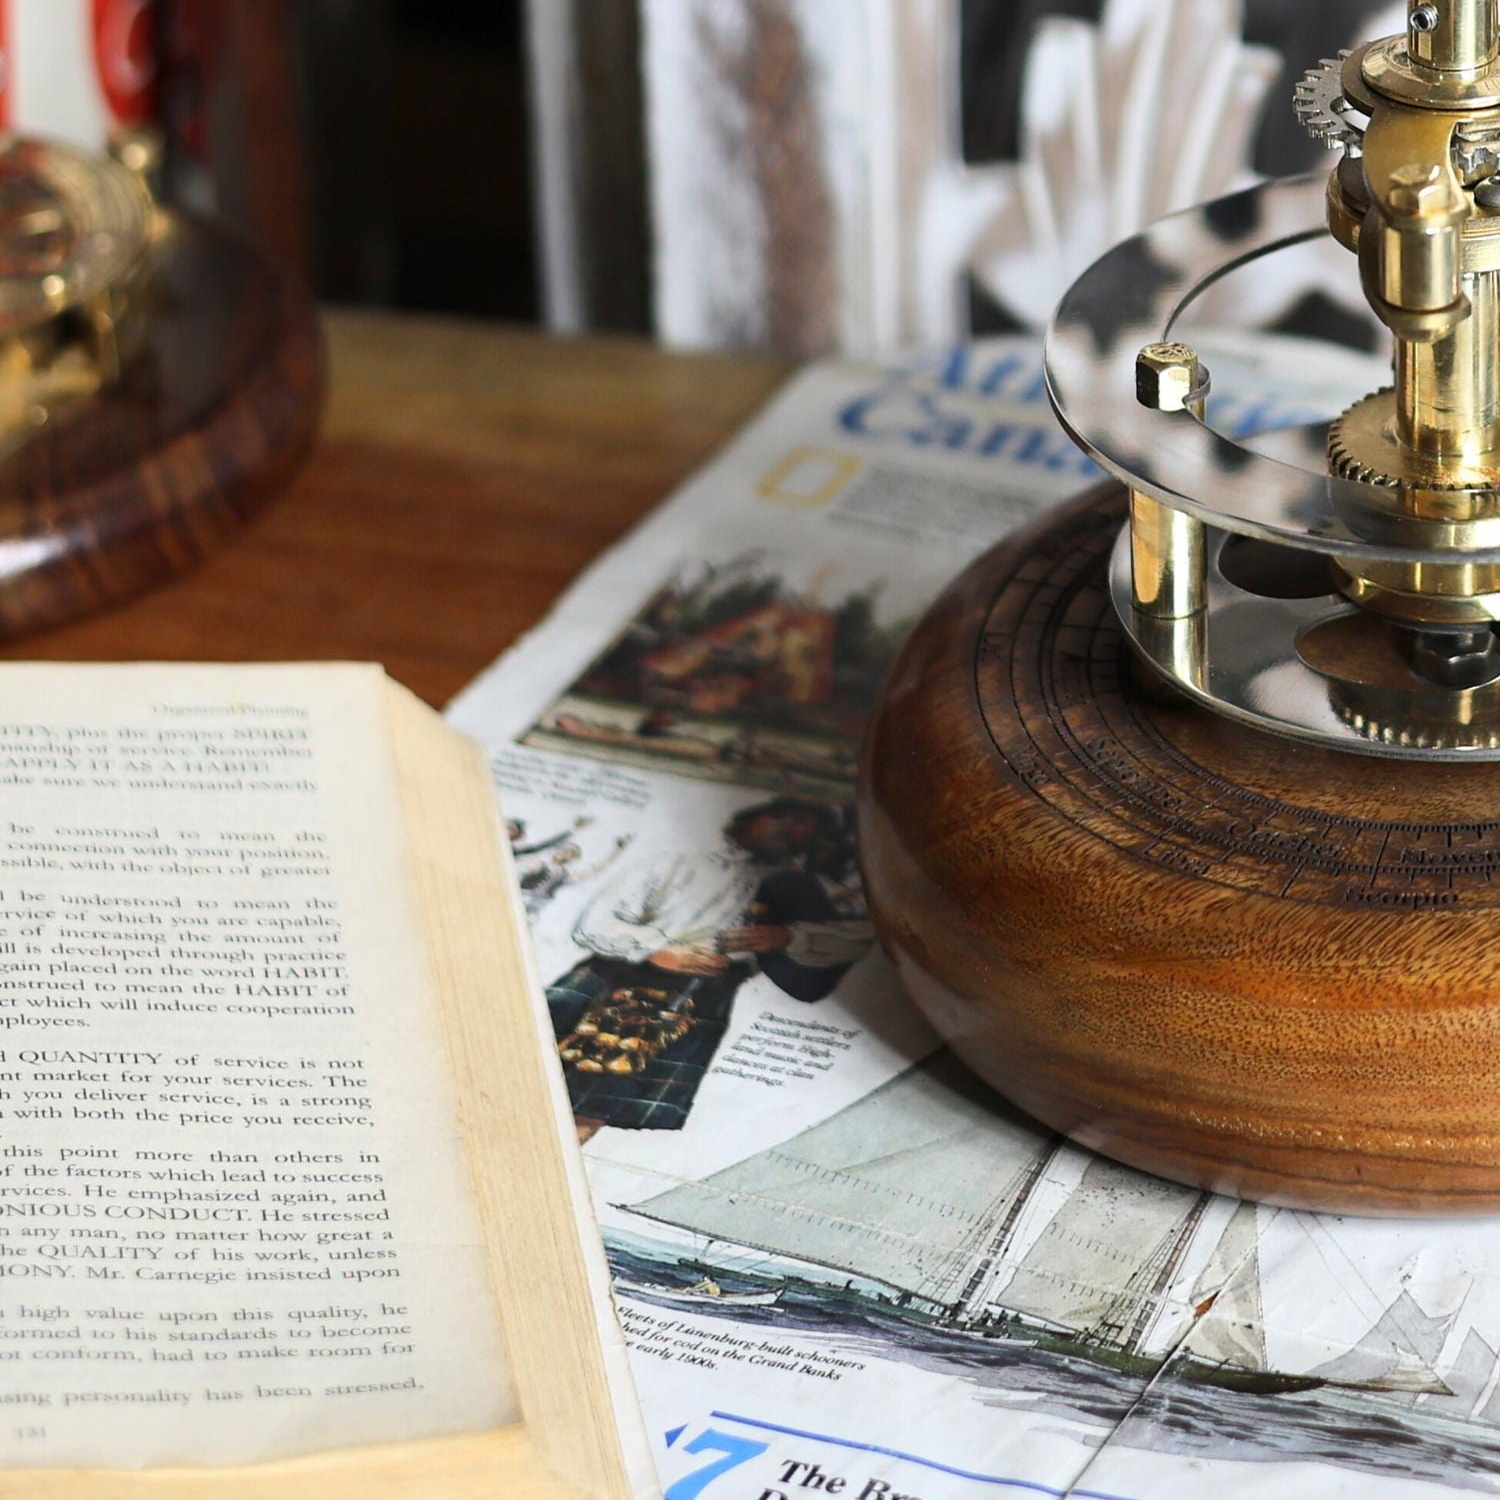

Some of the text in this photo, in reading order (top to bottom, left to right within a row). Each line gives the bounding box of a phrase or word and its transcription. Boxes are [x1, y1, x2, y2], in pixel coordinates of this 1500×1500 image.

[49, 961, 116, 975] placed
[161, 964, 192, 975] the
[200, 967, 254, 977] word
[264, 967, 346, 978] HABIT.
[26, 996, 354, 1017] which will induce cooperation
[18, 1051, 362, 1068] QUANTITY of service is not
[33, 1069, 366, 1087] market for your services. The
[13, 1106, 373, 1128] with both the price you receive,
[24, 1164, 383, 1182] the factors which lead to success
[85, 1184, 385, 1205] He emphasized again, and
[104, 1206, 389, 1221] CONDUCT. He stressed
[644, 1328, 672, 1342] for
[673, 1340, 703, 1350] cod
[701, 1347, 719, 1355] on
[722, 1349, 745, 1360] the
[748, 1355, 798, 1370] Grand
[798, 1364, 841, 1380] Banks
[657, 1321, 678, 1332] of
[794, 1350, 865, 1370] schooners
[636, 1344, 720, 1370] early 1900s.
[663, 1428, 847, 1500] 7 The
